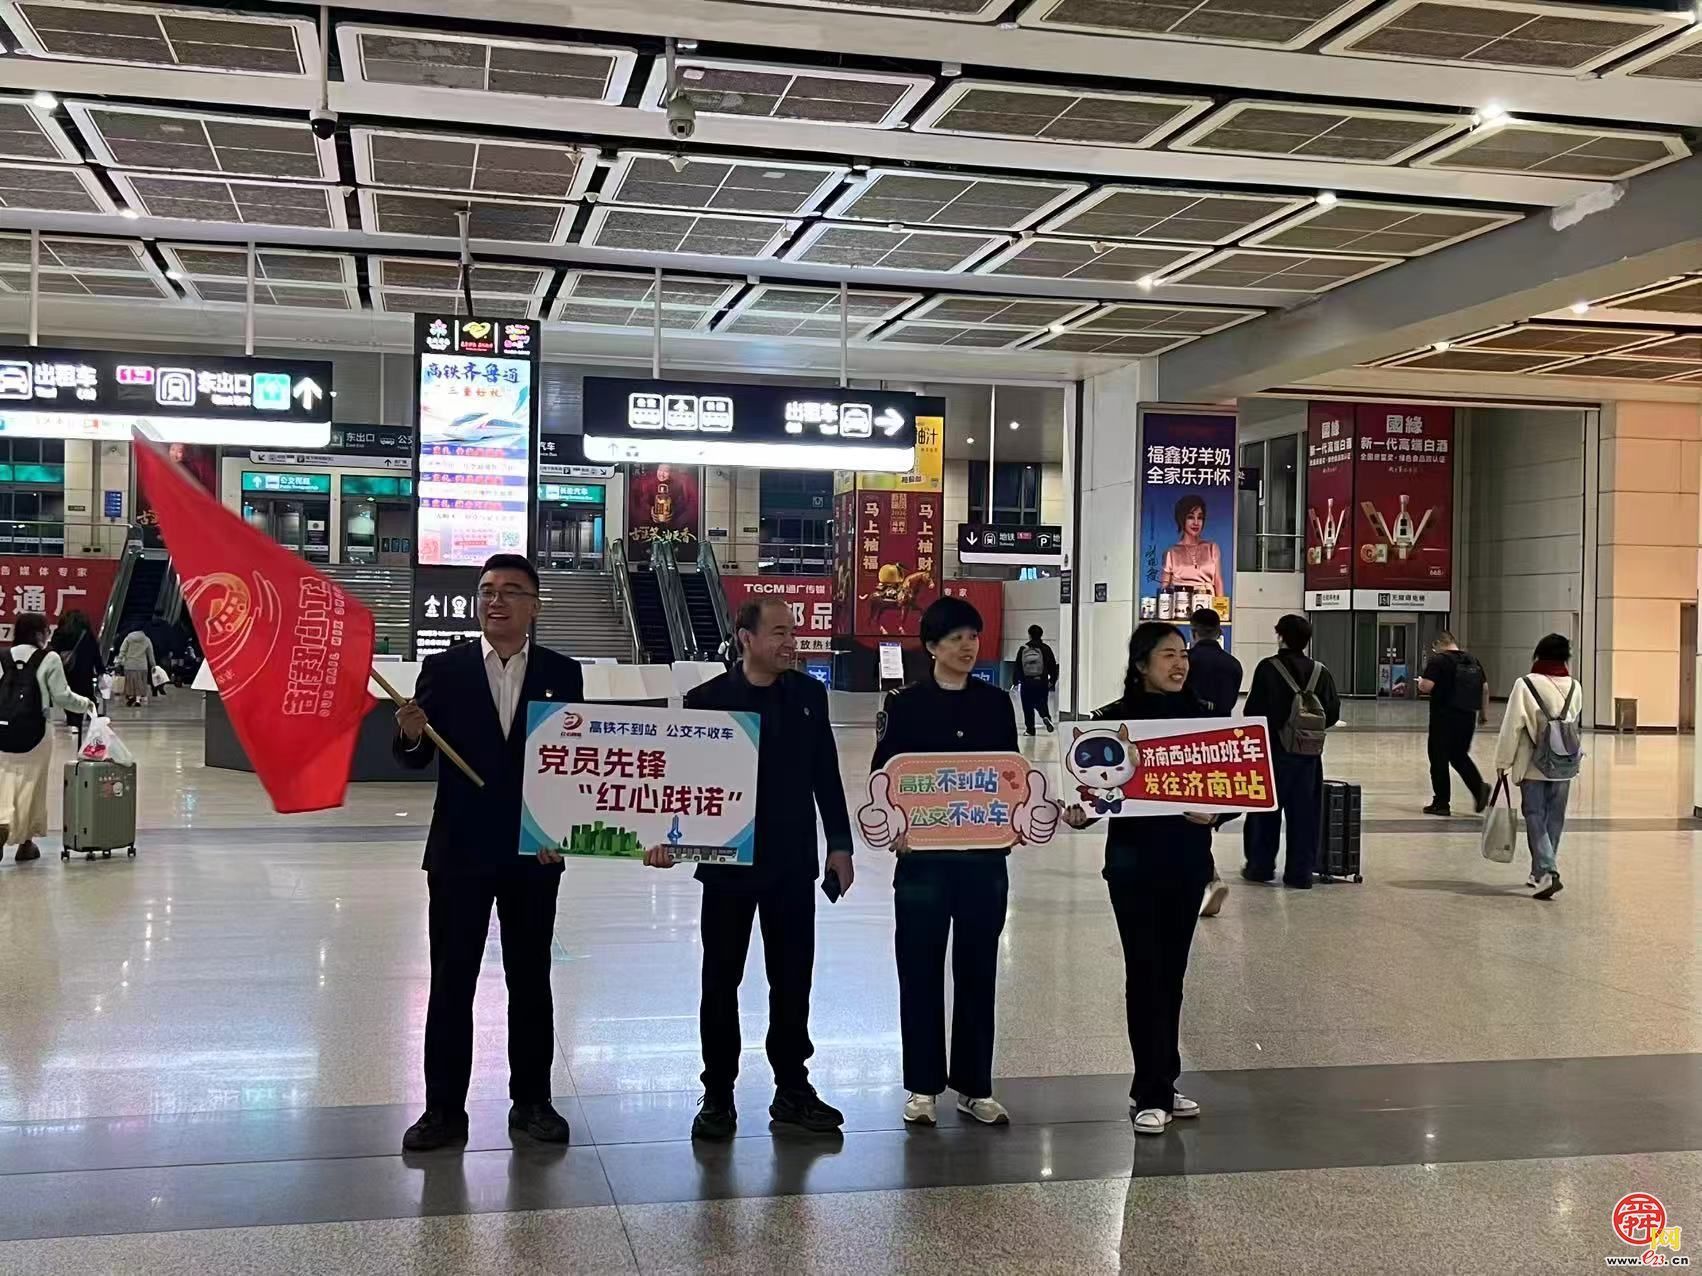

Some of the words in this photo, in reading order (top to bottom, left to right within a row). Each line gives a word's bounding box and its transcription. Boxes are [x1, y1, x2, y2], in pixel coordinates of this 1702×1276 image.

[34, 361, 98, 387] 出租车
[197, 370, 253, 395] 东出口
[427, 362, 520, 384] 高铁齐鲁通
[785, 400, 839, 423] 出租车
[345, 431, 376, 443] 东出口
[1360, 436, 1449, 453] 新一代高端白酒
[1147, 444, 1231, 466] 福鑫好羊奶
[1146, 466, 1231, 486] 全家乐开怀
[863, 502, 880, 570] 马上柚福
[918, 504, 934, 571] 马上柚财
[744, 583, 825, 595] TGCM通广传媒
[589, 720, 658, 737] 高铁不到站
[666, 723, 734, 741] 公交不收车
[537, 744, 667, 780] 党员先锋
[1142, 736, 1265, 768] 济南西站加班车
[899, 767, 998, 795] 高铁不到站
[1144, 769, 1267, 801] 发往济南站
[578, 781, 743, 817] “红心践诺”
[910, 799, 1010, 828] 公交不收车
